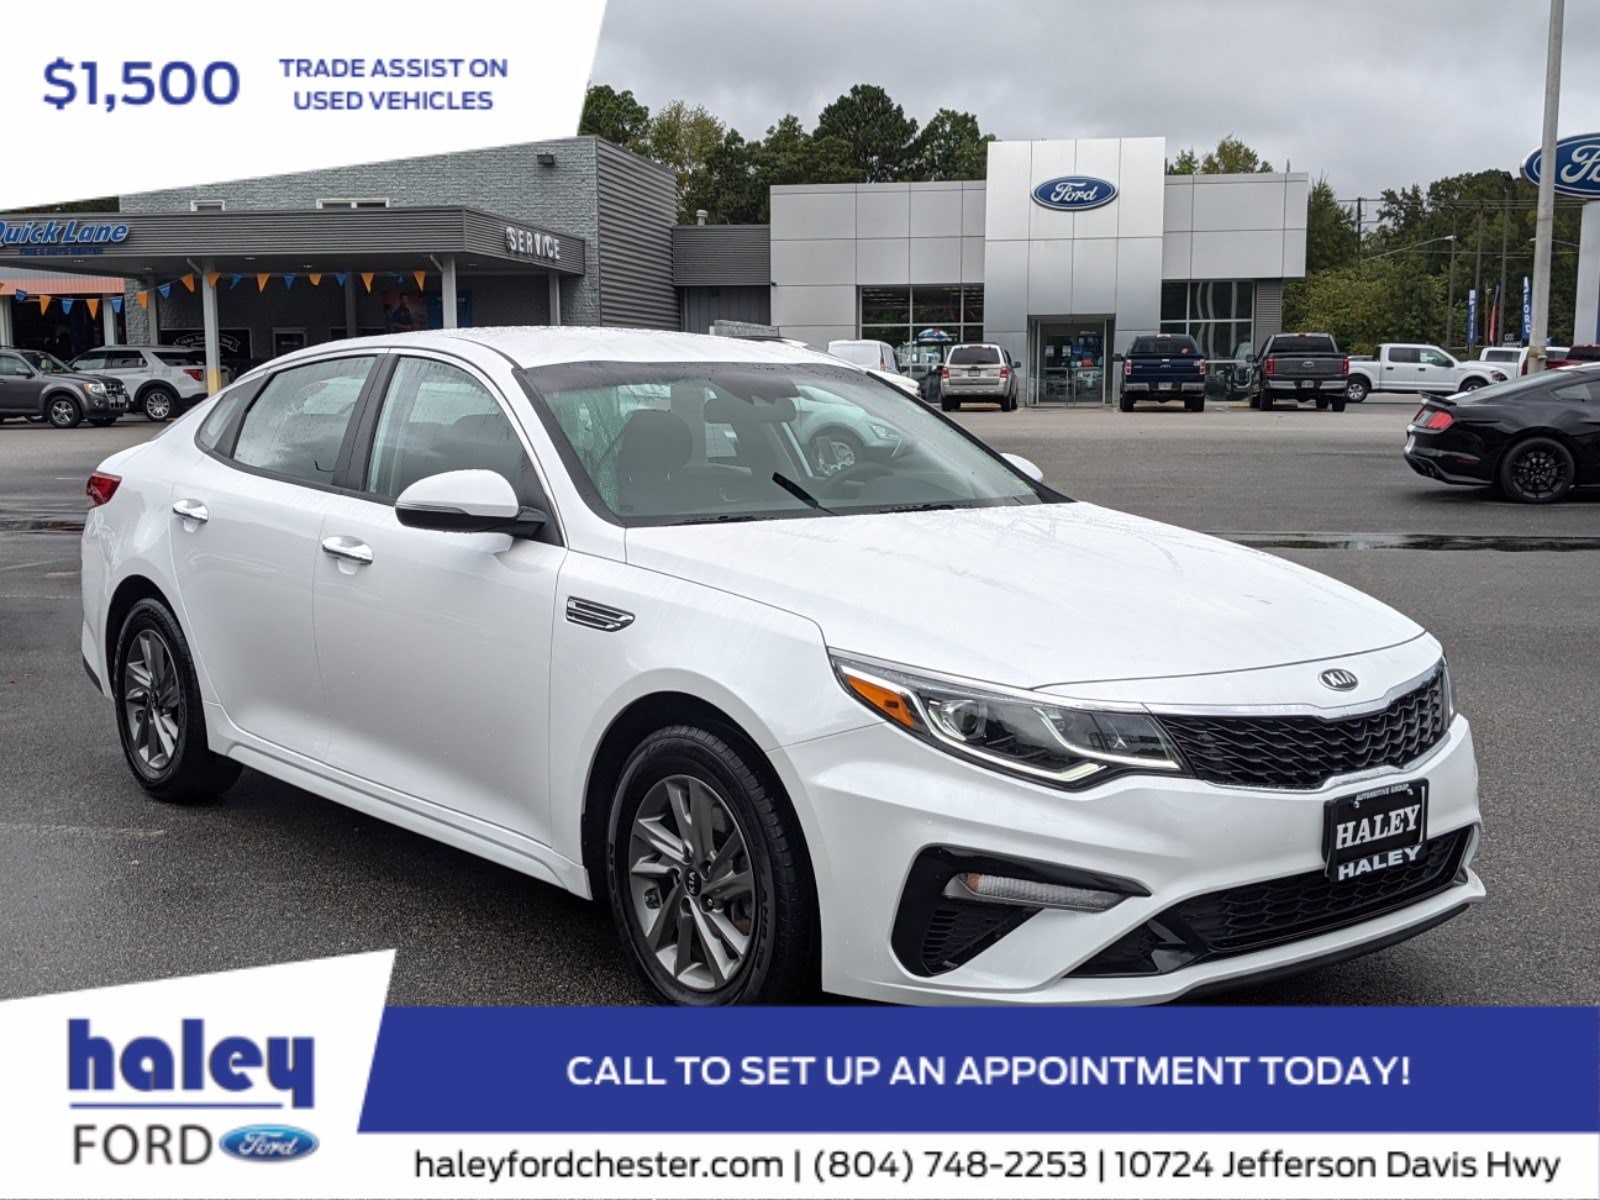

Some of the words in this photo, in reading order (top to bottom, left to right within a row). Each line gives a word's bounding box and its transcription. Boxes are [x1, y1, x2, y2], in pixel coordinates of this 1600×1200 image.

[1050, 182, 1099, 202] Ford
[61, 219, 129, 243] Lane
[505, 226, 560, 260] SERVICE
[1323, 671, 1356, 686] KIA
[1336, 804, 1421, 850] HALEY
[1338, 846, 1423, 882] HALEY
